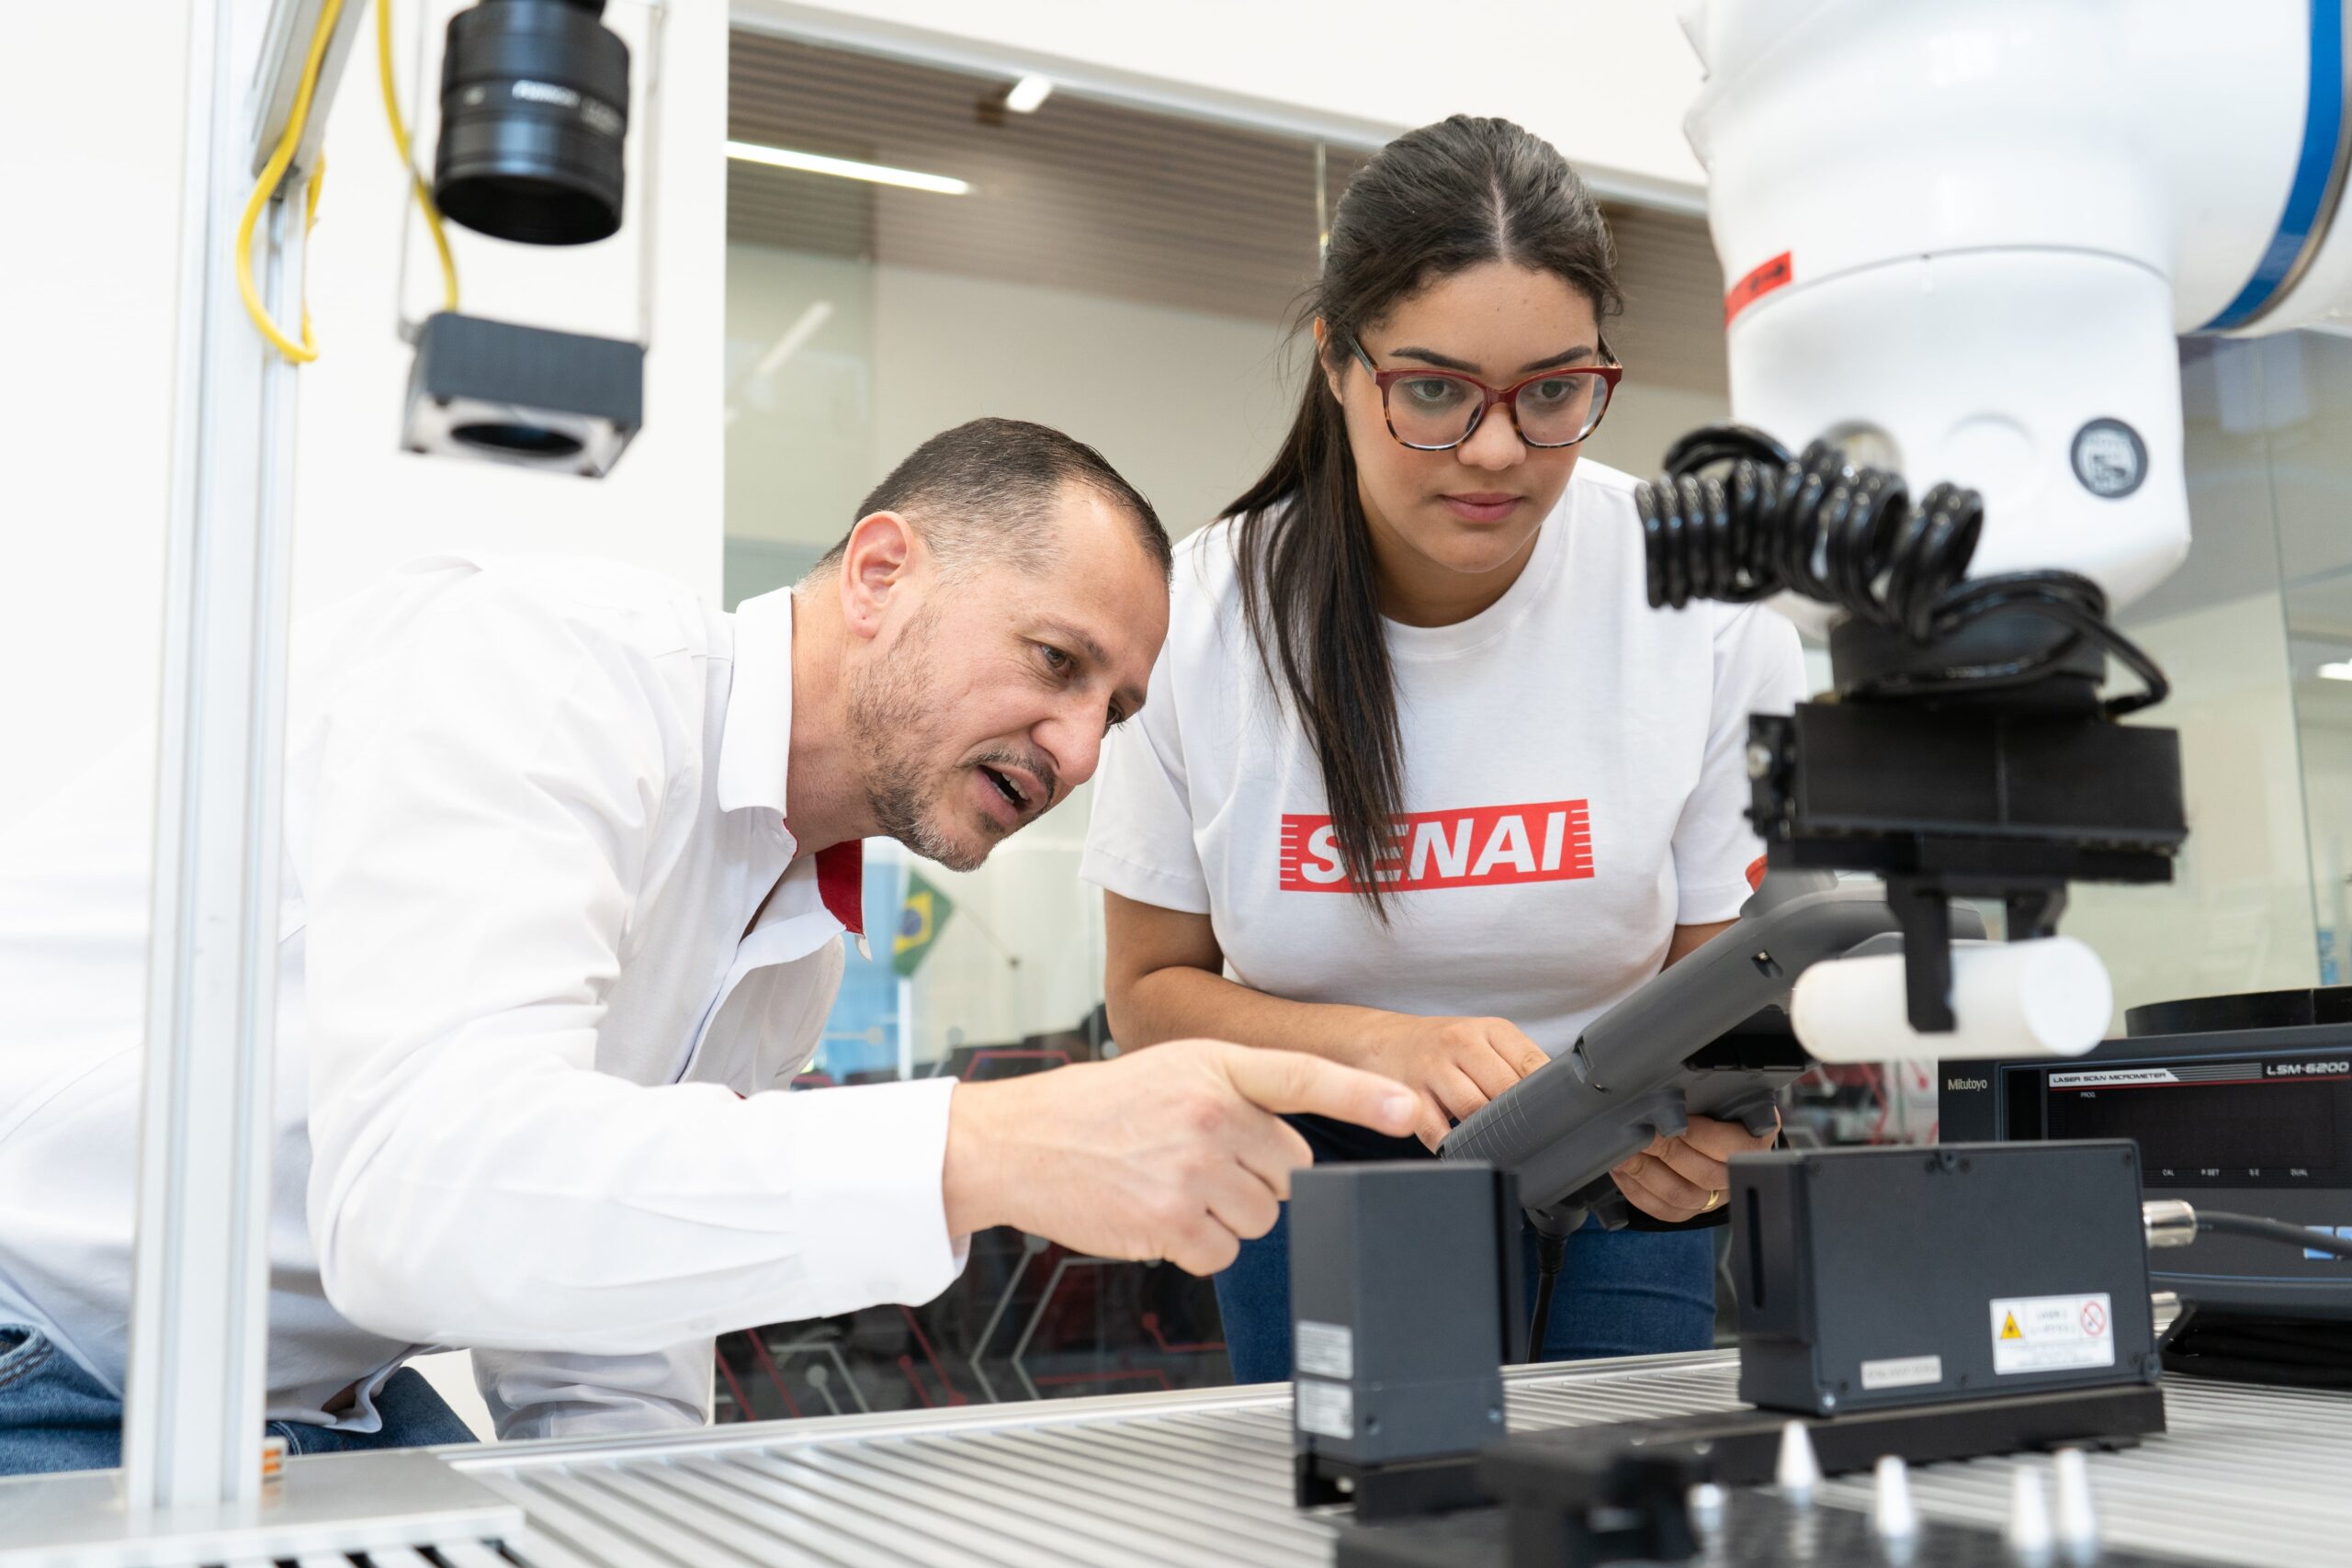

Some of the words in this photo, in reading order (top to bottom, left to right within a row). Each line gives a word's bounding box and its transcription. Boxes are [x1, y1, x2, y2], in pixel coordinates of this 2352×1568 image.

[1301, 811, 1566, 884] SENAI
[2266, 1061, 2350, 1076] LSM-6200
[2109, 1072, 2166, 1081] MICROMETER
[1947, 1077, 1987, 1092] Mitutoyo
